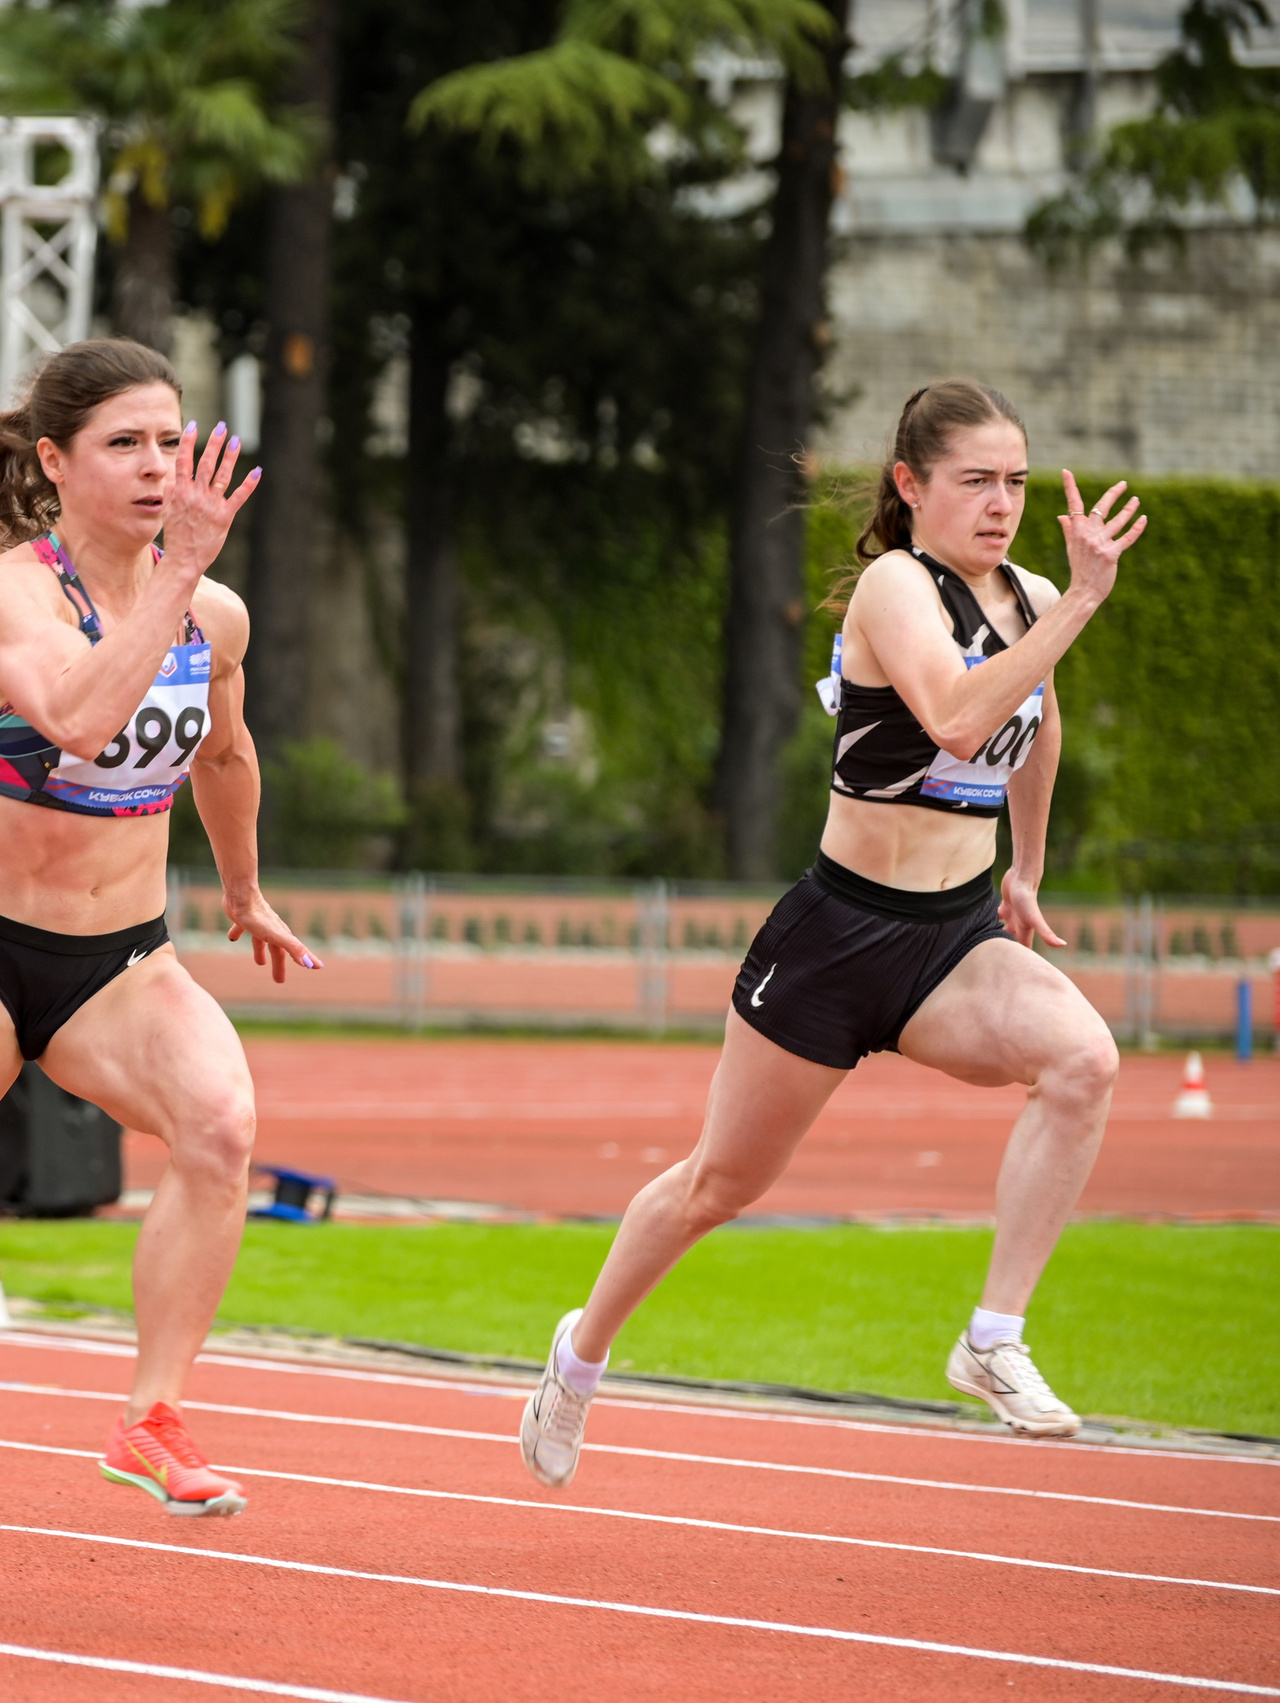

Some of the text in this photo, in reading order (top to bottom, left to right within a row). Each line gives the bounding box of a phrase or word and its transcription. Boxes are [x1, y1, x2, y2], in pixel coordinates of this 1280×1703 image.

[968, 715, 1040, 768] 00
[88, 788, 167, 802] КУБОК СОЧИ
